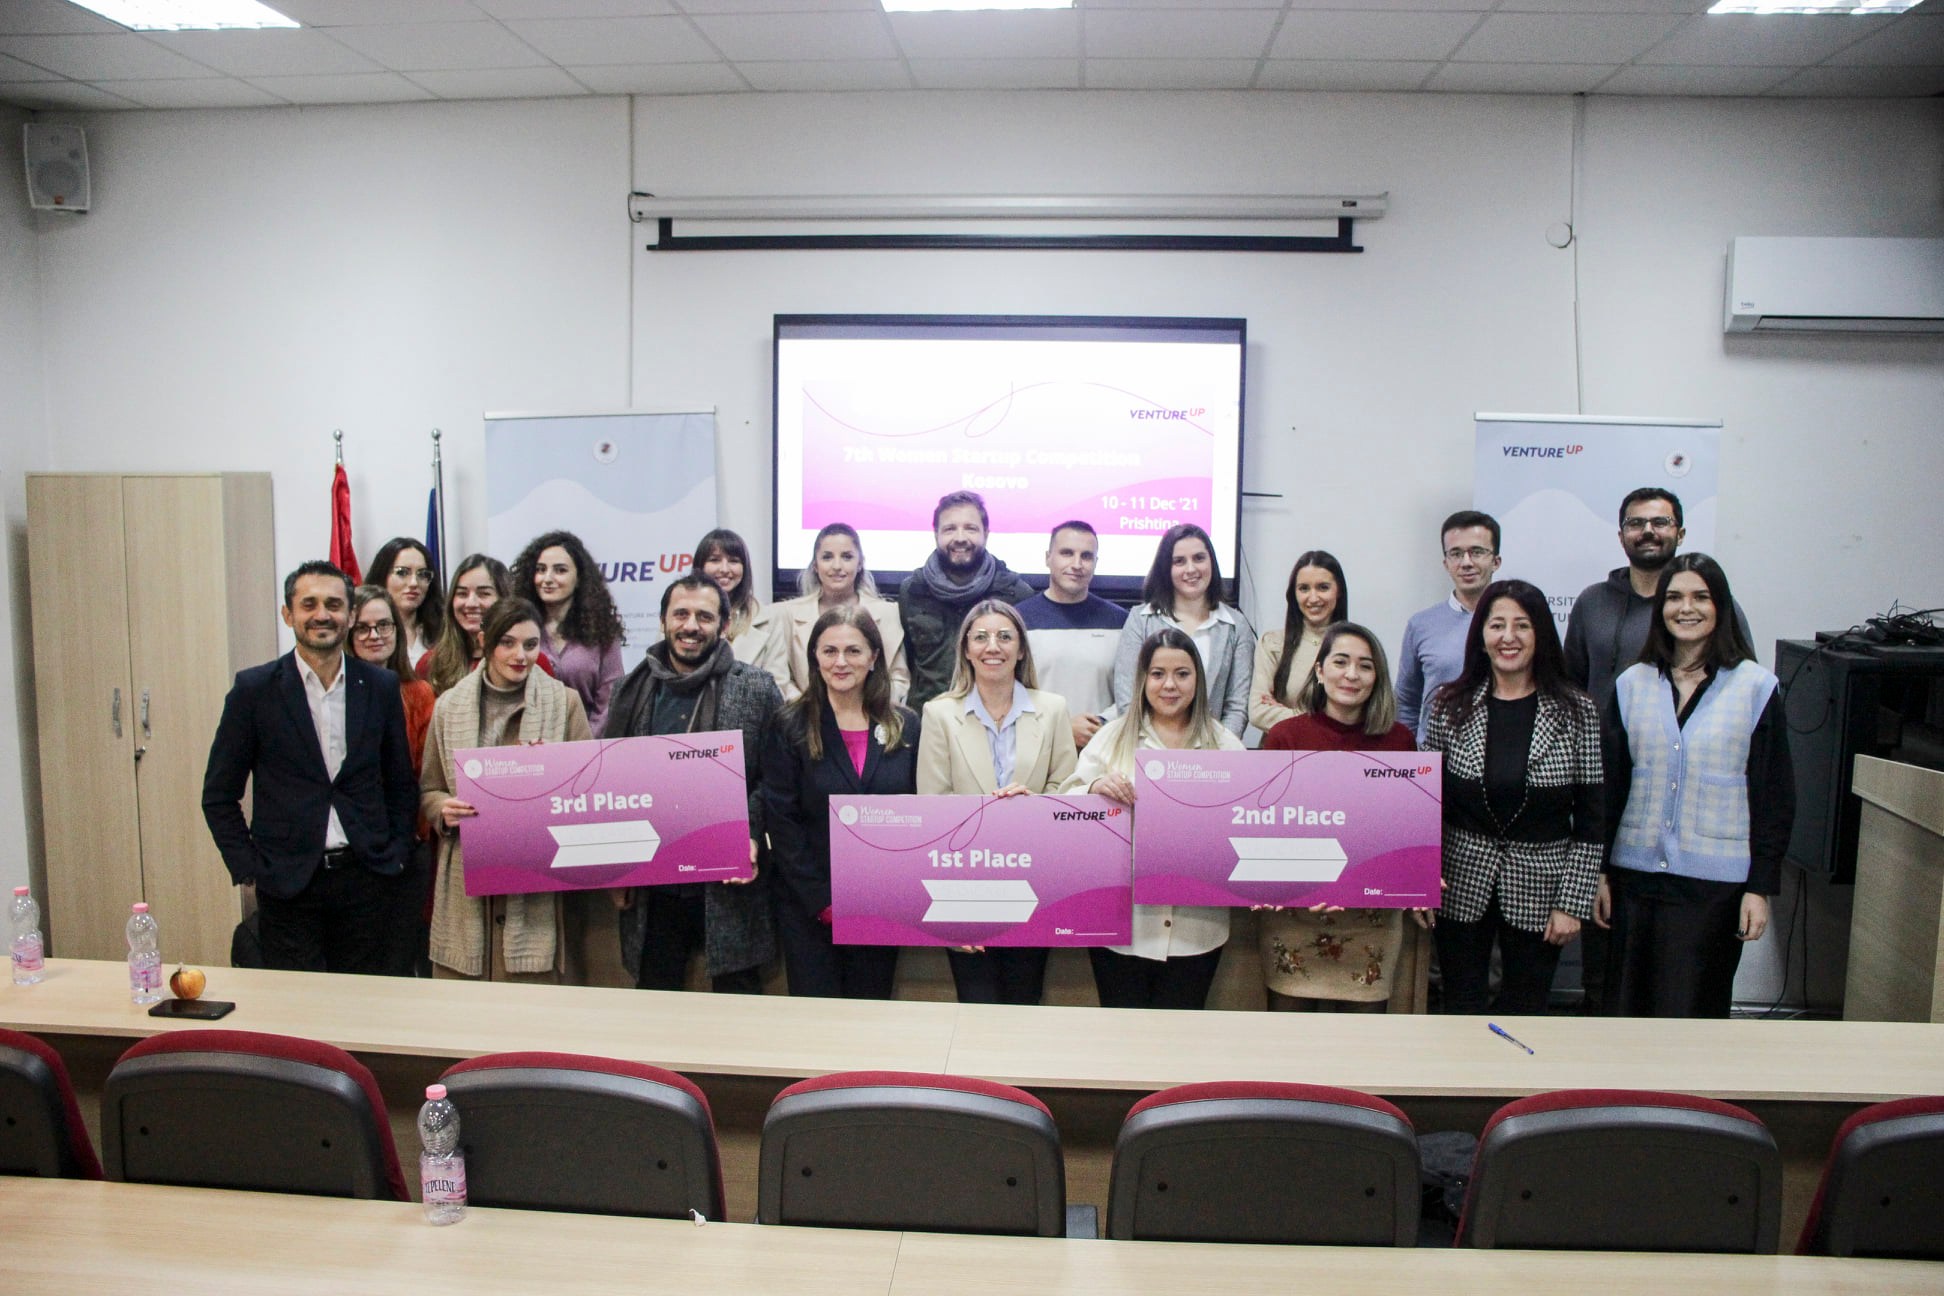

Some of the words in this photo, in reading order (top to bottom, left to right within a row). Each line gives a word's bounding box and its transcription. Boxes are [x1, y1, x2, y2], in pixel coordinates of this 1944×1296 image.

[1130, 409, 1187, 420] VENTURE
[1189, 408, 1206, 417] UP
[843, 447, 874, 463] 7th
[878, 447, 947, 463] Women
[951, 448, 1022, 468] Startup
[1026, 449, 1141, 469] Competition
[1502, 446, 1565, 458] VENTURE
[1566, 445, 1583, 455] UP
[962, 473, 1029, 489] Kosovo
[1102, 496, 1118, 509] 10
[1131, 497, 1145, 510] 11
[1150, 497, 1176, 510] Dec
[1179, 497, 1198, 511] '21
[600, 561, 655, 583] URE
[659, 553, 693, 573] UP
[668, 748, 719, 760] VENTURE
[720, 745, 735, 753] UP
[1363, 767, 1416, 778] VENTURE
[1417, 766, 1432, 775] UP
[549, 794, 588, 815] 3rd
[594, 792, 653, 812] Place
[1053, 811, 1106, 821] VENTURE
[1107, 808, 1121, 816] UP
[1231, 806, 1275, 825] 2nd
[1283, 806, 1346, 825] Place
[928, 849, 963, 868] 1st
[970, 849, 1032, 868] Place
[1055, 927, 1074, 935] Date:
